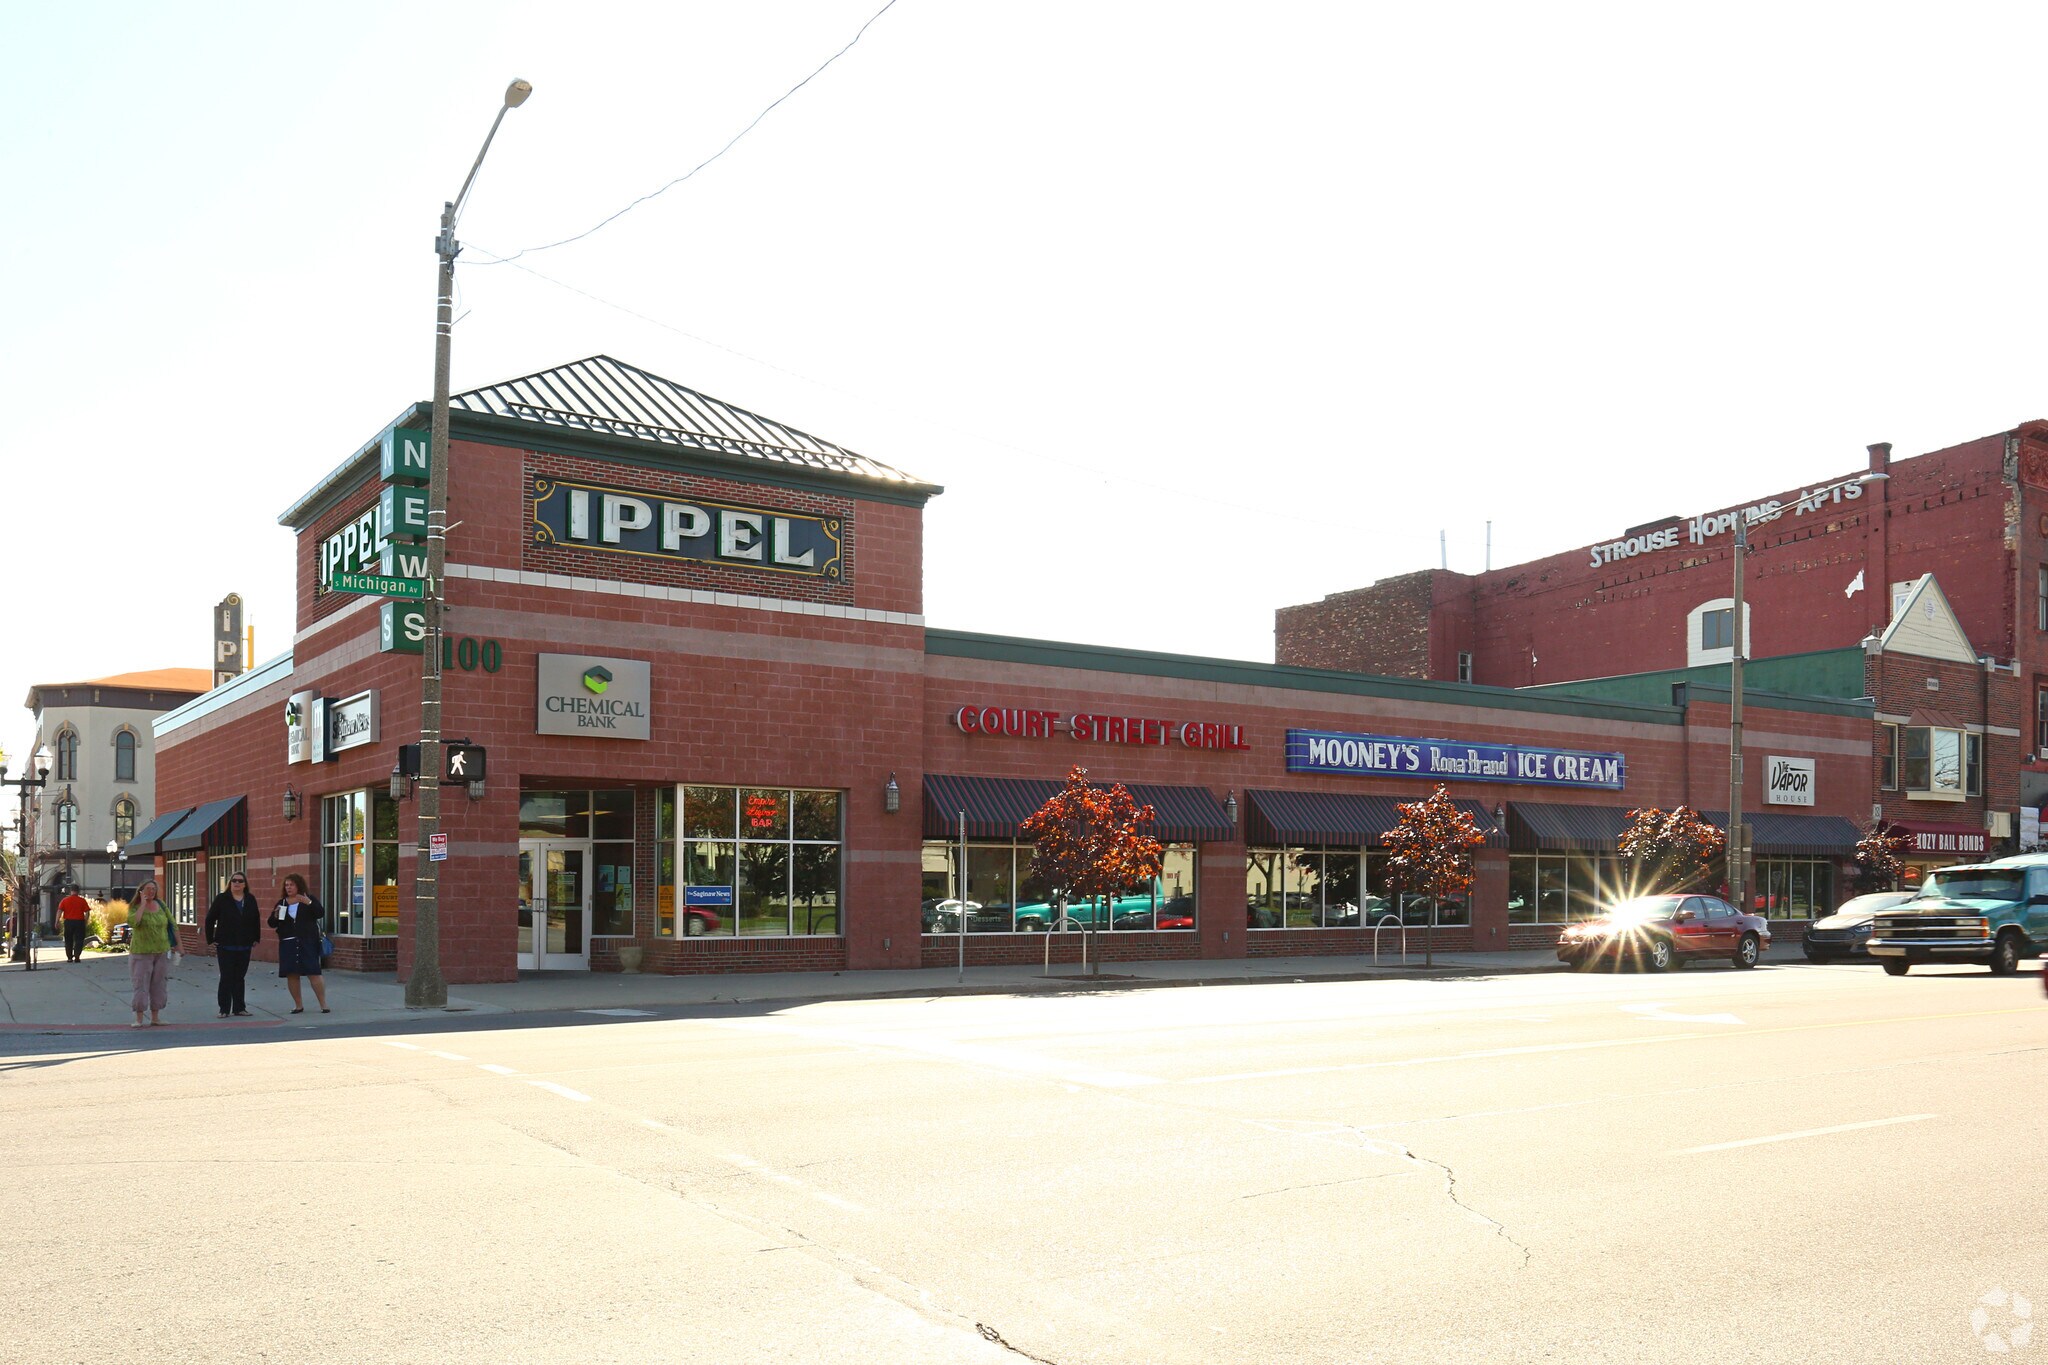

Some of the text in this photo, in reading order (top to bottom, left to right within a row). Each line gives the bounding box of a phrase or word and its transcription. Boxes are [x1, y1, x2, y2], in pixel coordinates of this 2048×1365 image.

[566, 489, 814, 567] IPPEL
[1590, 526, 1679, 568] STROUSE
[1795, 482, 1863, 516] APTS
[322, 504, 388, 586] IPPEL
[343, 574, 406, 594] Michigan
[442, 637, 502, 673] 100
[545, 696, 645, 718] CHEMICAL
[577, 714, 616, 728] BANK
[957, 705, 1250, 750] COURT STREET GRILL
[1308, 738, 1420, 771] MOONEY'S
[1517, 753, 1547, 778] ICE
[1553, 755, 1618, 783] CREAM
[1771, 762, 1808, 792] VAPOR
[1776, 795, 1807, 803] HOUSE
[751, 818, 772, 827] BAR
[1917, 833, 1984, 851] KOZY BAIL BONDS
